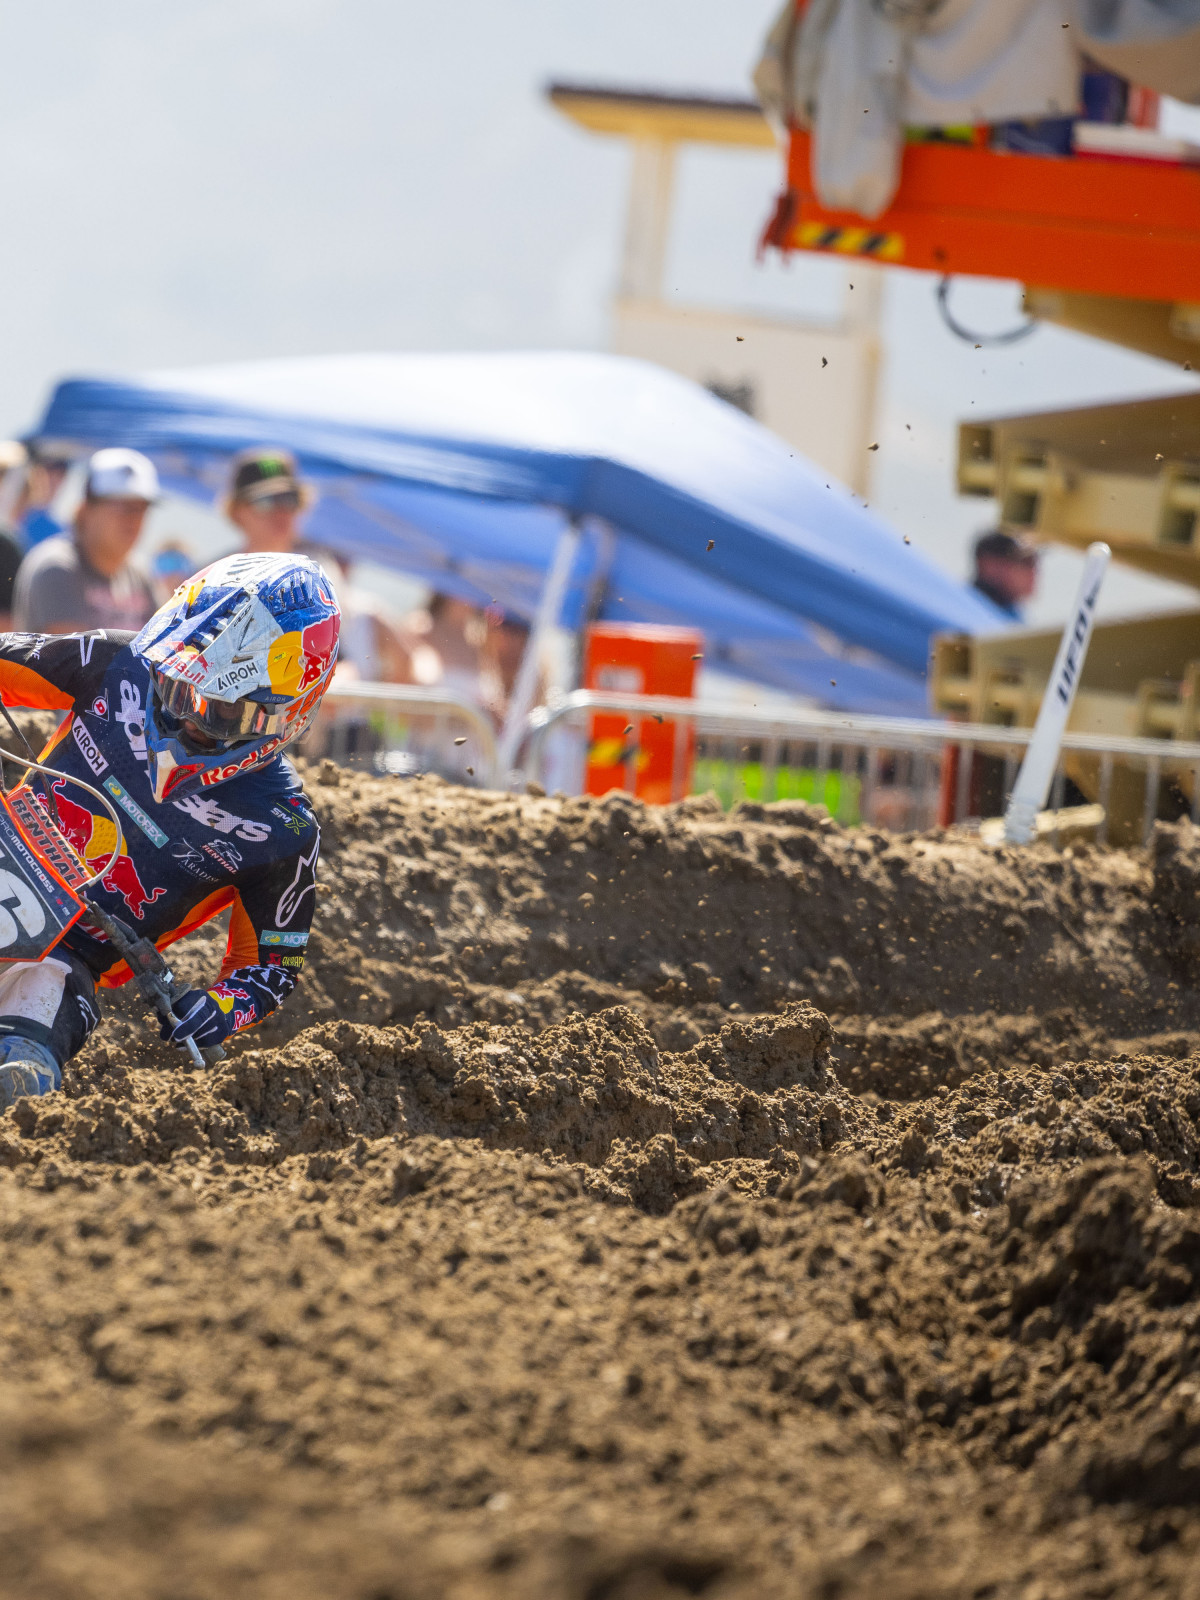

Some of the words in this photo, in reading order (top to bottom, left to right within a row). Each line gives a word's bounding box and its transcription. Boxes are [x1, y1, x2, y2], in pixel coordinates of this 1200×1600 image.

[176, 660, 206, 684] Bull
[217, 662, 259, 691] AIROH
[74, 724, 104, 771] AIROH
[201, 749, 258, 786] Red
[119, 799, 164, 844] MOTOREX
[11, 798, 77, 887] RENTHAL
[201, 844, 238, 875] RENTHAL
